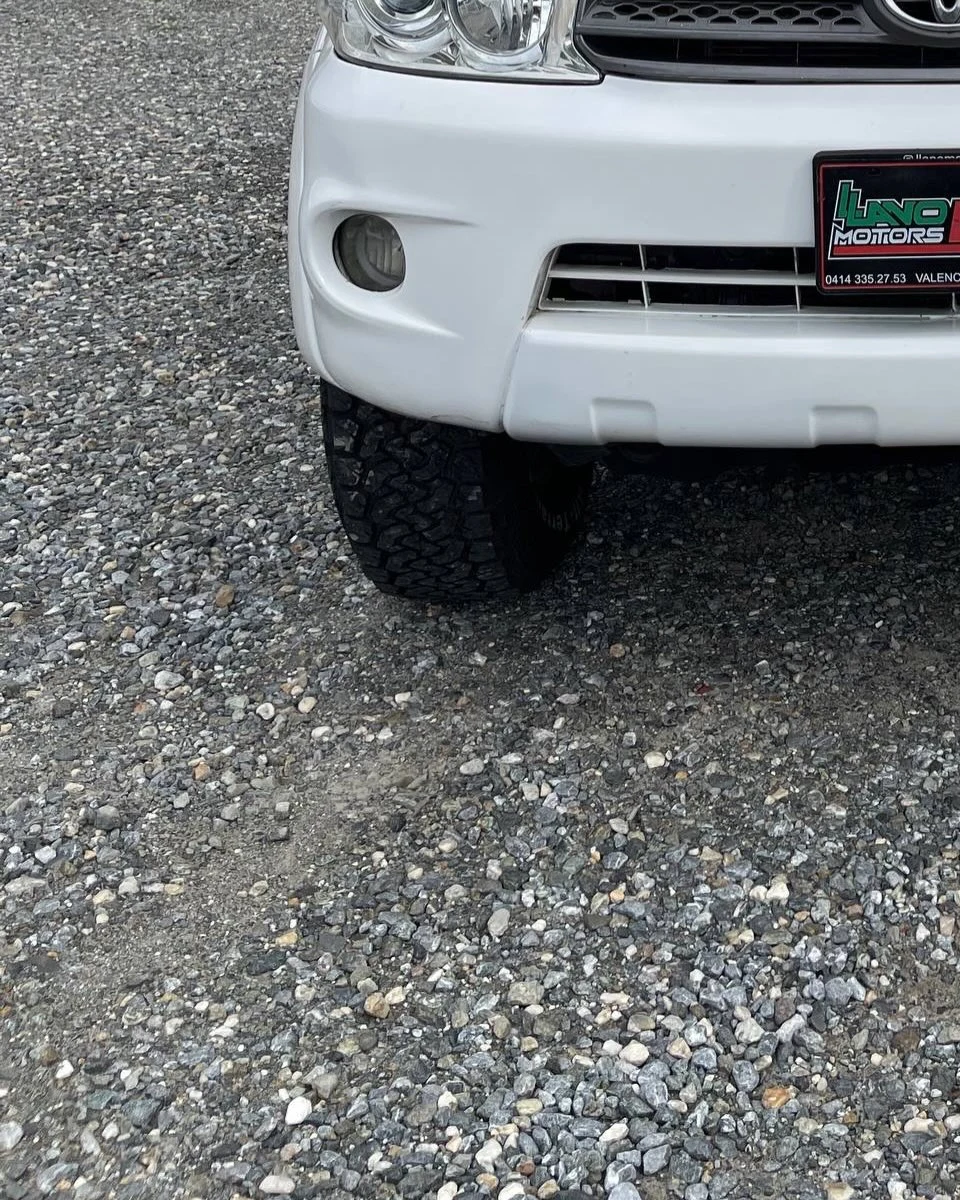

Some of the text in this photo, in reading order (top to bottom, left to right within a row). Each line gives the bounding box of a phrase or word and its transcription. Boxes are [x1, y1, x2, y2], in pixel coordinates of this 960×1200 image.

[836, 181, 948, 227] LLANO
[833, 227, 945, 246] MOTORS
[825, 274, 851, 285] 0414
[854, 273, 907, 284] 335.27.53
